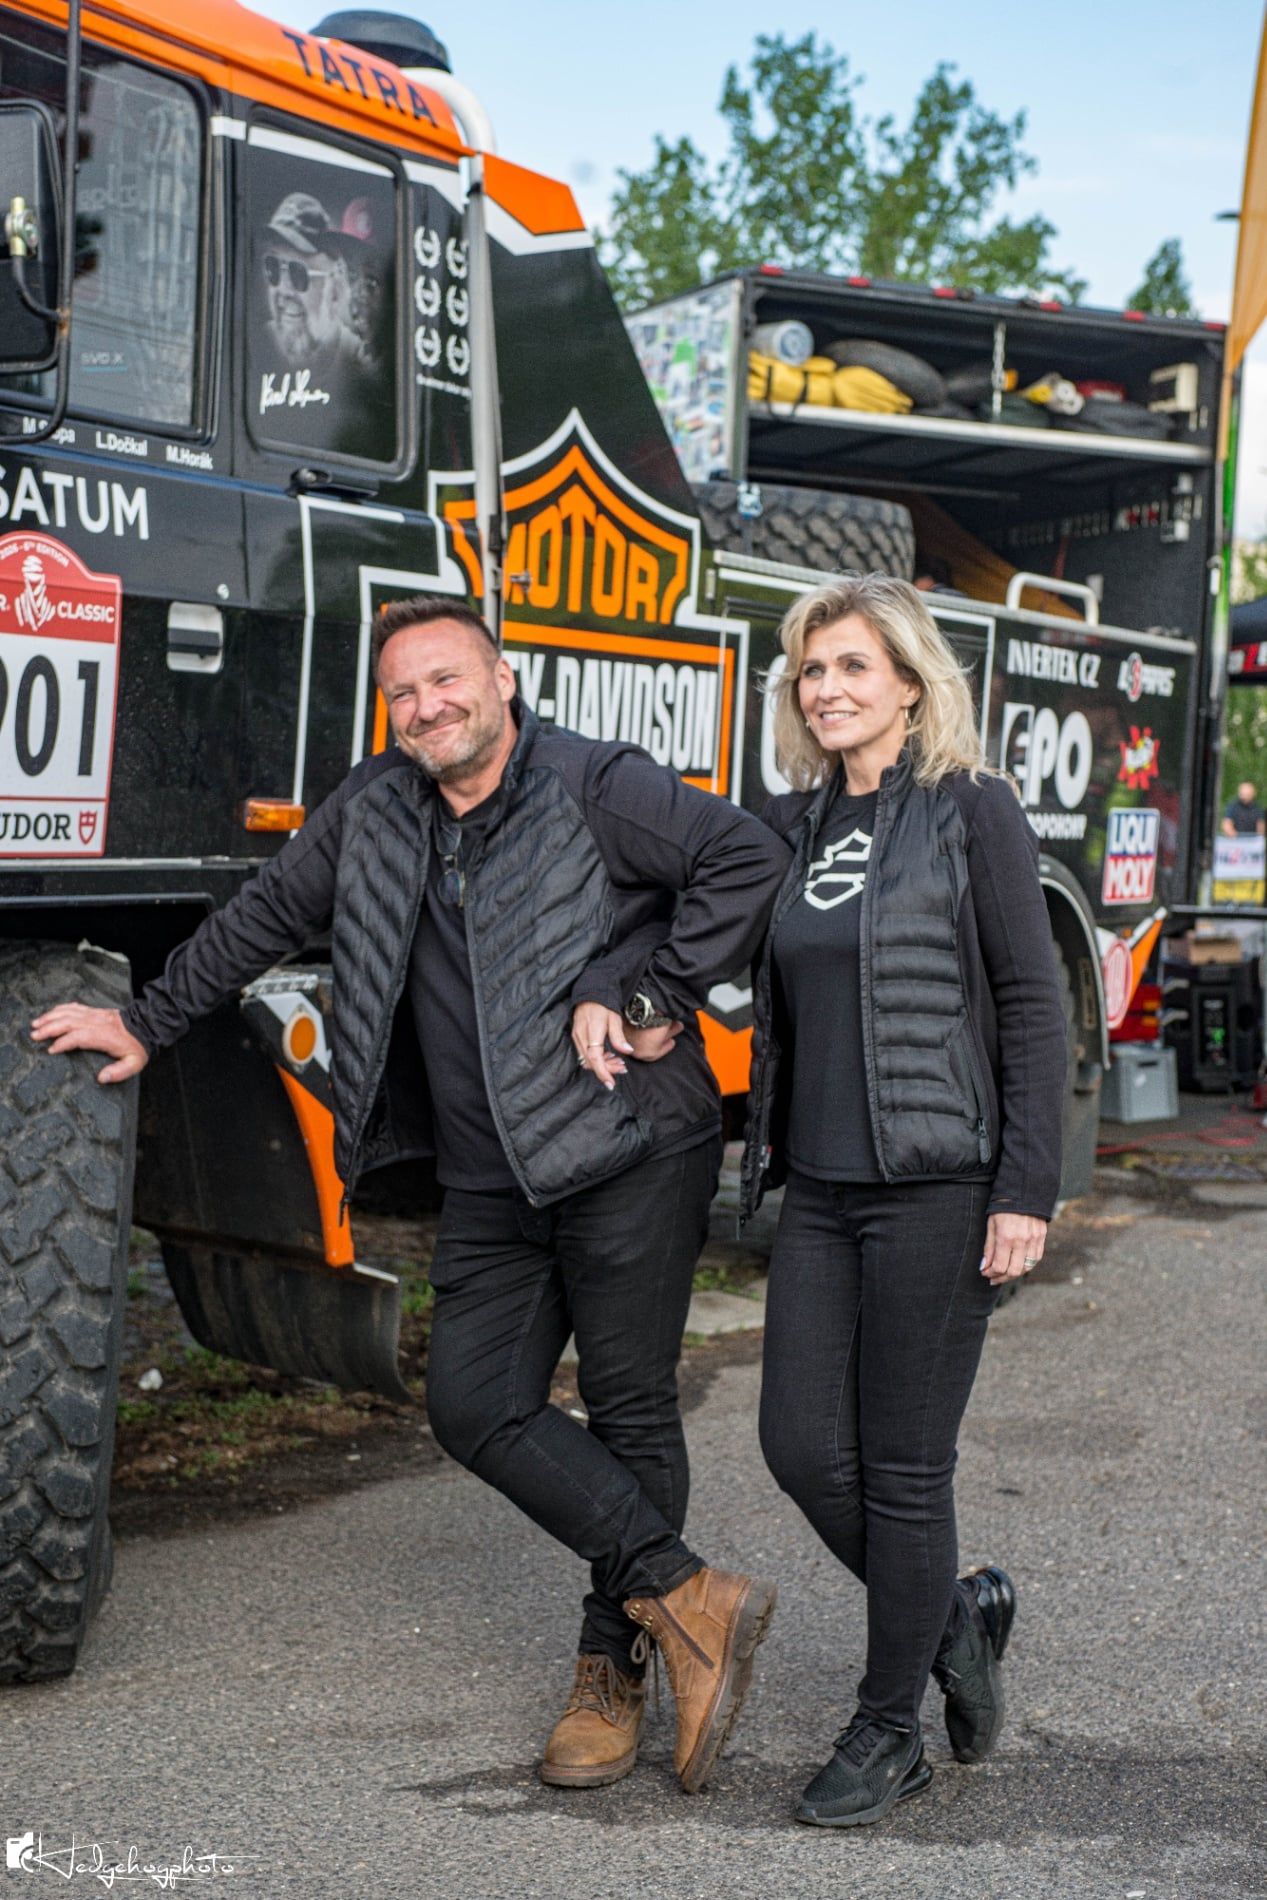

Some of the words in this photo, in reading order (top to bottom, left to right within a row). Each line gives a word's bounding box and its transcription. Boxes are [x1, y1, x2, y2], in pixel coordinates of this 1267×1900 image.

[282, 29, 438, 128] TATRA
[57, 600, 115, 623] CLASSIC
[1079, 652, 1101, 688] CZ
[0, 655, 100, 777] 01
[502, 651, 718, 771] Y-DAVIDSON
[1112, 813, 1157, 855] LIQUI
[1105, 856, 1155, 898] MOLY
